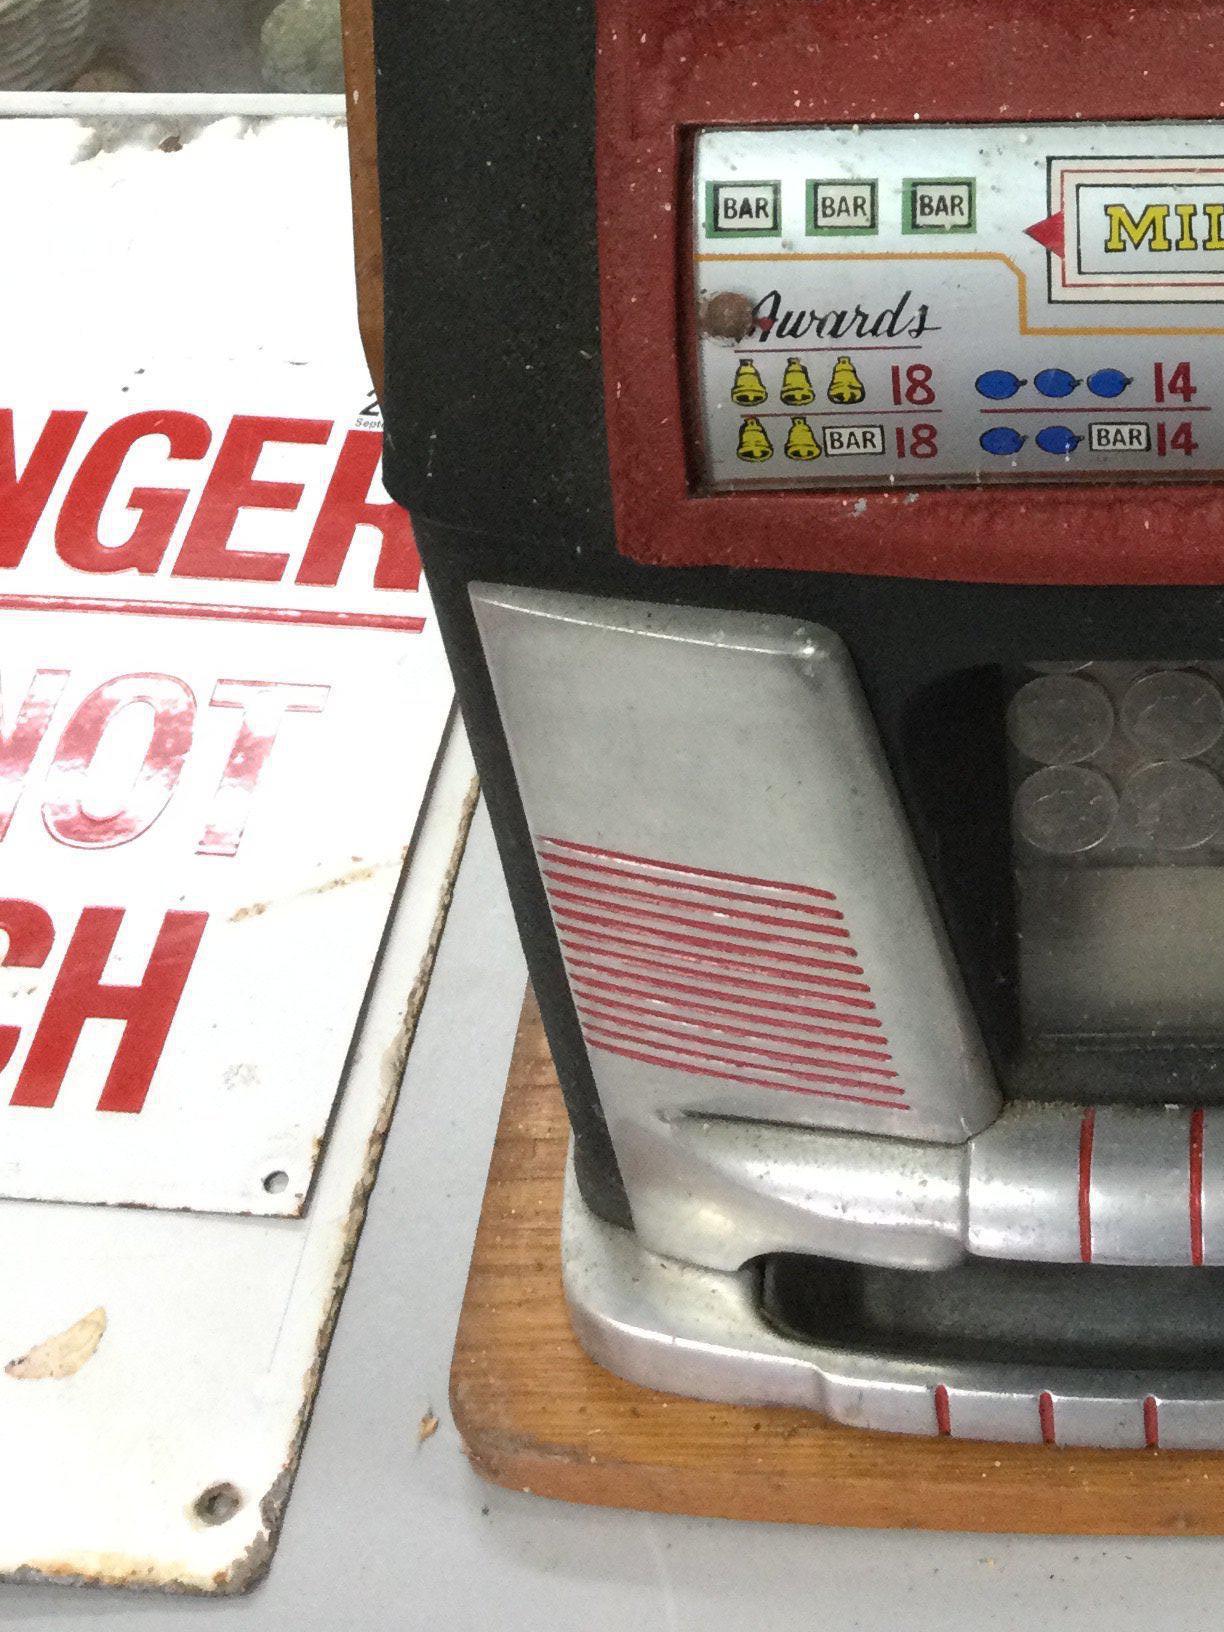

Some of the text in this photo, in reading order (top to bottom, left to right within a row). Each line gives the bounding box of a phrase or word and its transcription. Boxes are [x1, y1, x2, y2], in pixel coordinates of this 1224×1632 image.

[722, 193, 966, 220] BAR BAR BAR
[735, 289, 942, 343] Awards
[890, 363, 937, 407] 18
[1153, 361, 1199, 404] 14
[828, 423, 939, 459] BAR 18
[1096, 421, 1199, 458] BAR 14
